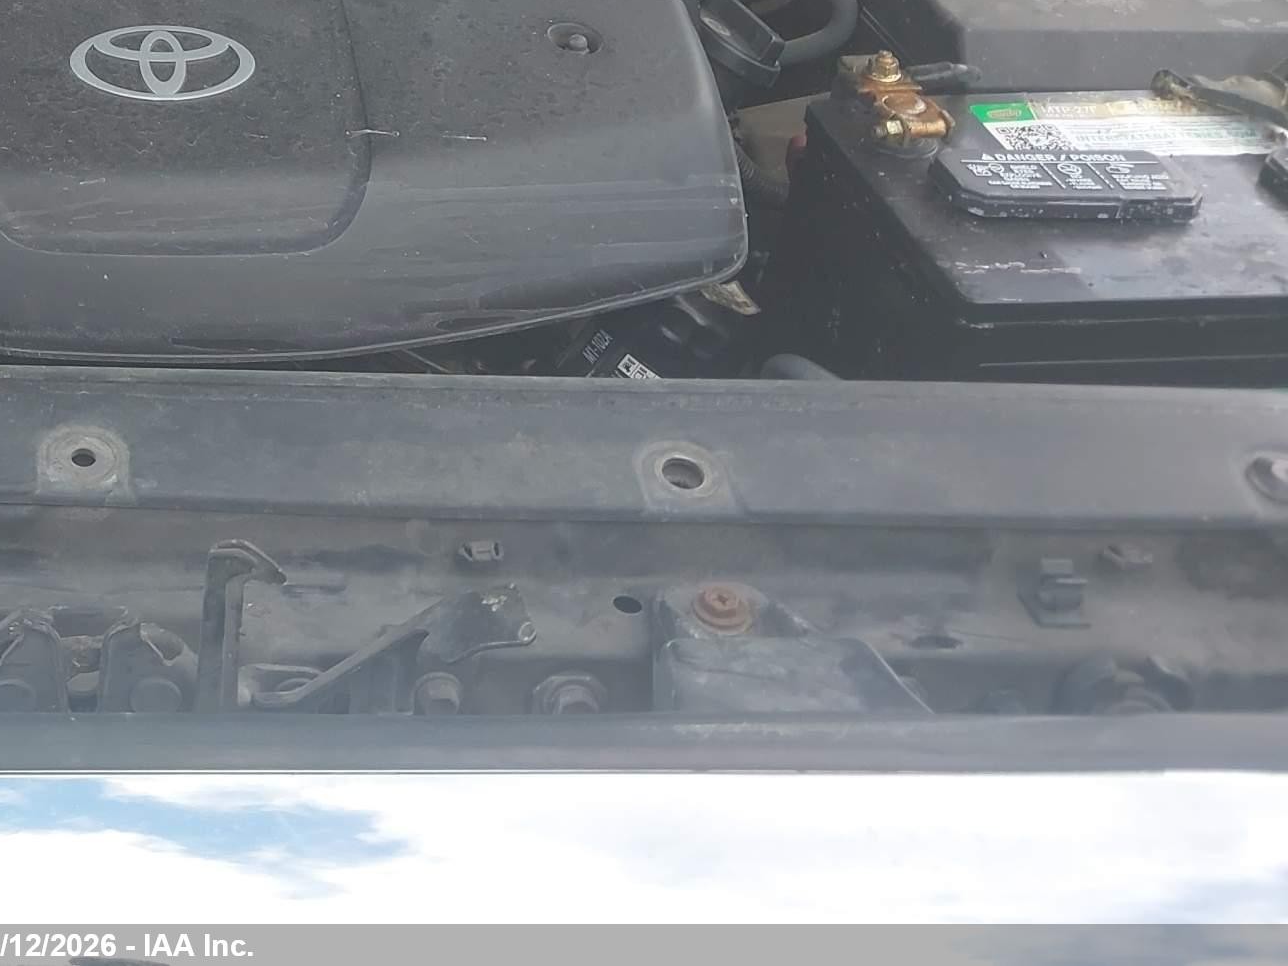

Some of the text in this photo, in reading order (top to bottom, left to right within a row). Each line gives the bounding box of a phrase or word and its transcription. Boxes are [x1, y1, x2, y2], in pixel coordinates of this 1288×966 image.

[995, 153, 1056, 161] DANGER
[1070, 153, 1127, 161] POISON
[582, 329, 614, 364] M1-102A
